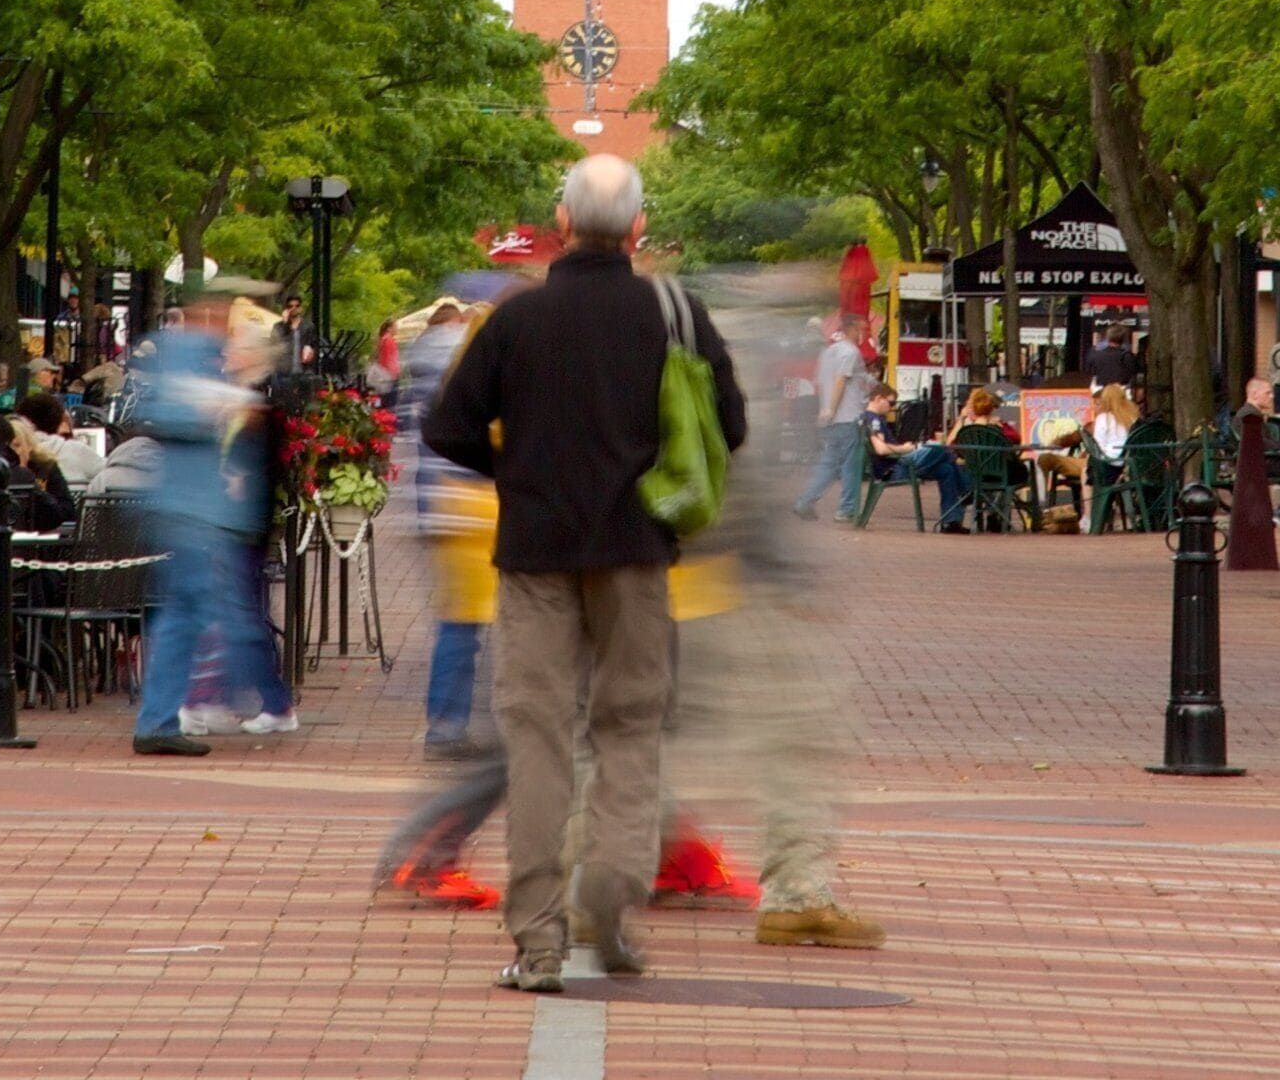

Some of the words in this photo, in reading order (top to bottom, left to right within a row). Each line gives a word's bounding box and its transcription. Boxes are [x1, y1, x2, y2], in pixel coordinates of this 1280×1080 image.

[1060, 221, 1097, 233] THE
[1031, 230, 1097, 242] NORTH
[1050, 240, 1097, 250] FACE
[979, 271, 1035, 284] NEER
[1041, 271, 1084, 284] STOP
